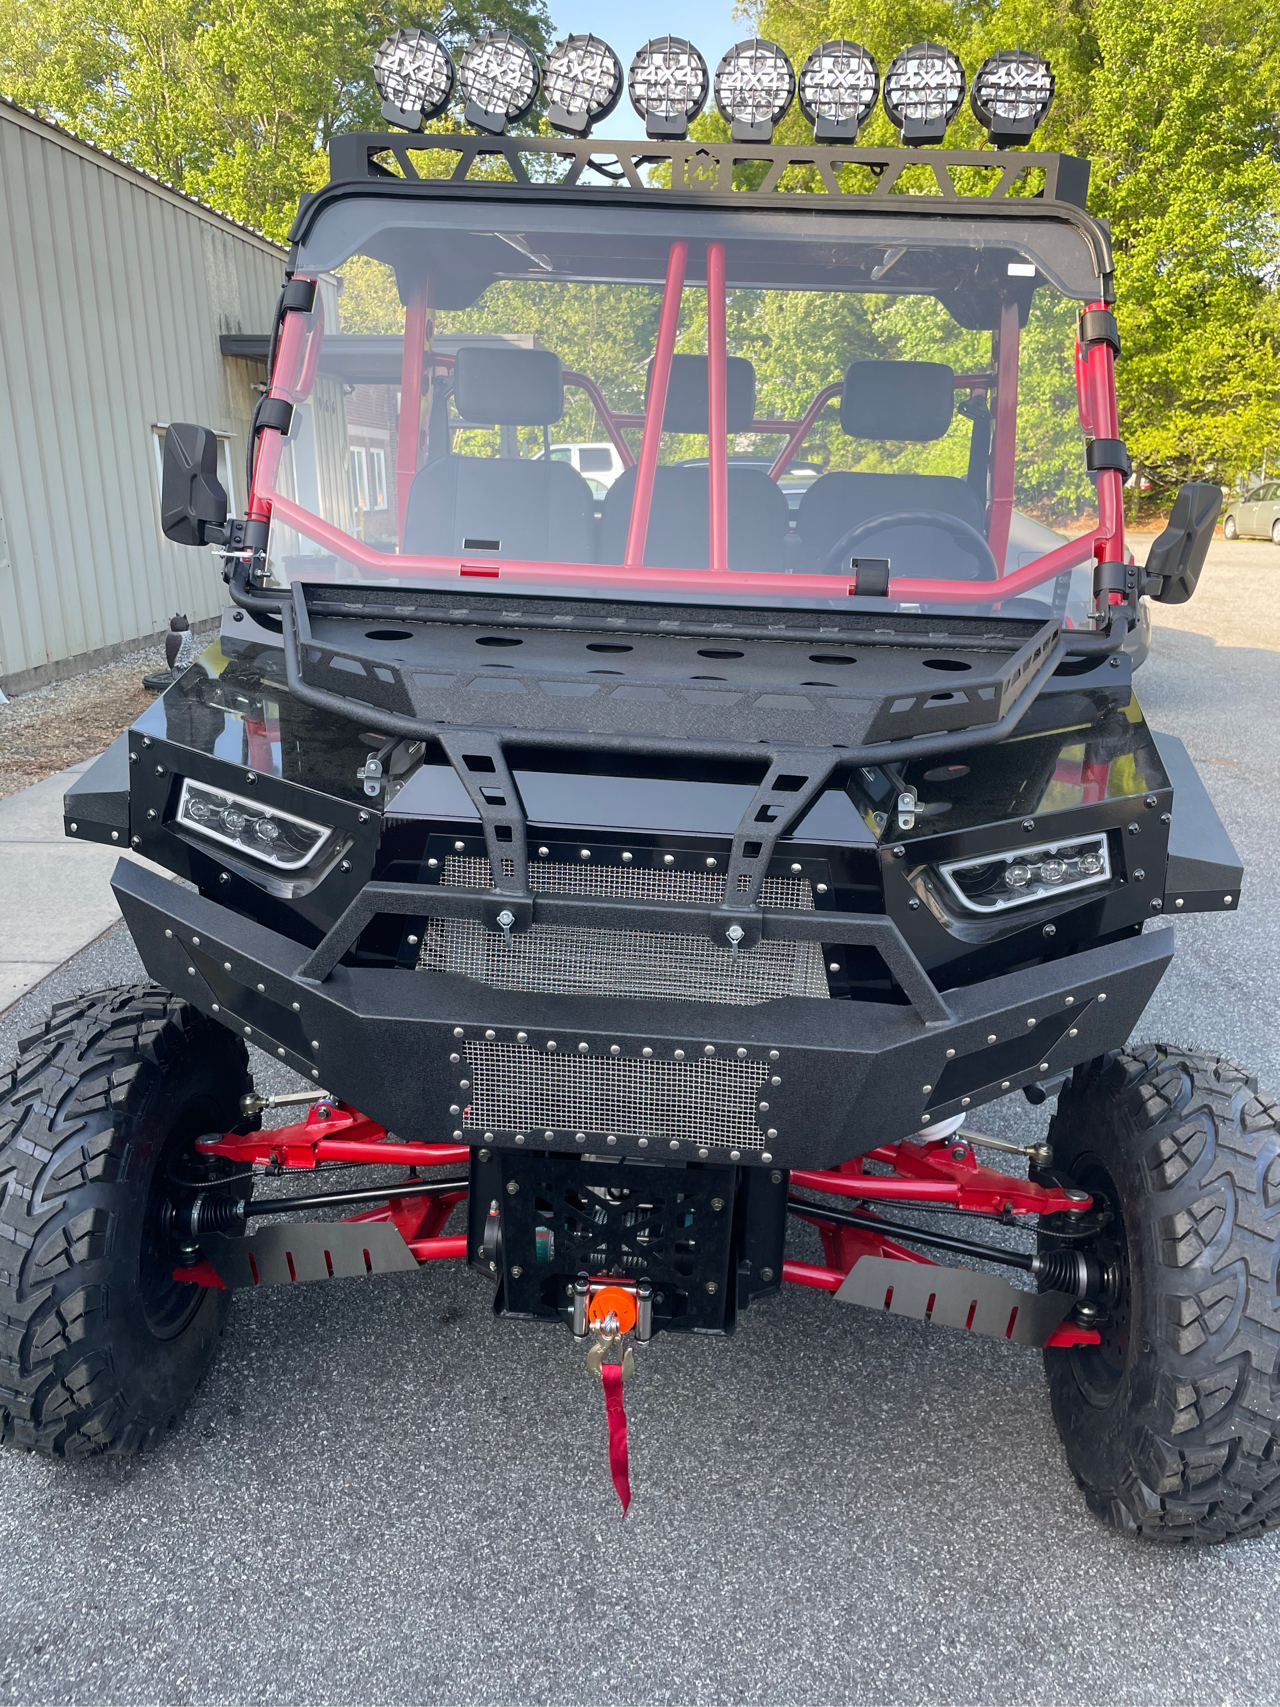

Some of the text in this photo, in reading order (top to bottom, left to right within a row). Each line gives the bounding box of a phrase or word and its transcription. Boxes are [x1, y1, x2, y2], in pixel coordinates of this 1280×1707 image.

[382, 55, 434, 85] 4X4
[470, 57, 522, 89] 4X4
[552, 57, 602, 84] 4X4
[641, 64, 697, 84] 4X4
[727, 70, 781, 91] 4X4
[813, 68, 867, 89] 4X4
[900, 67, 953, 89] 4X4
[990, 70, 1044, 89] 4X4
